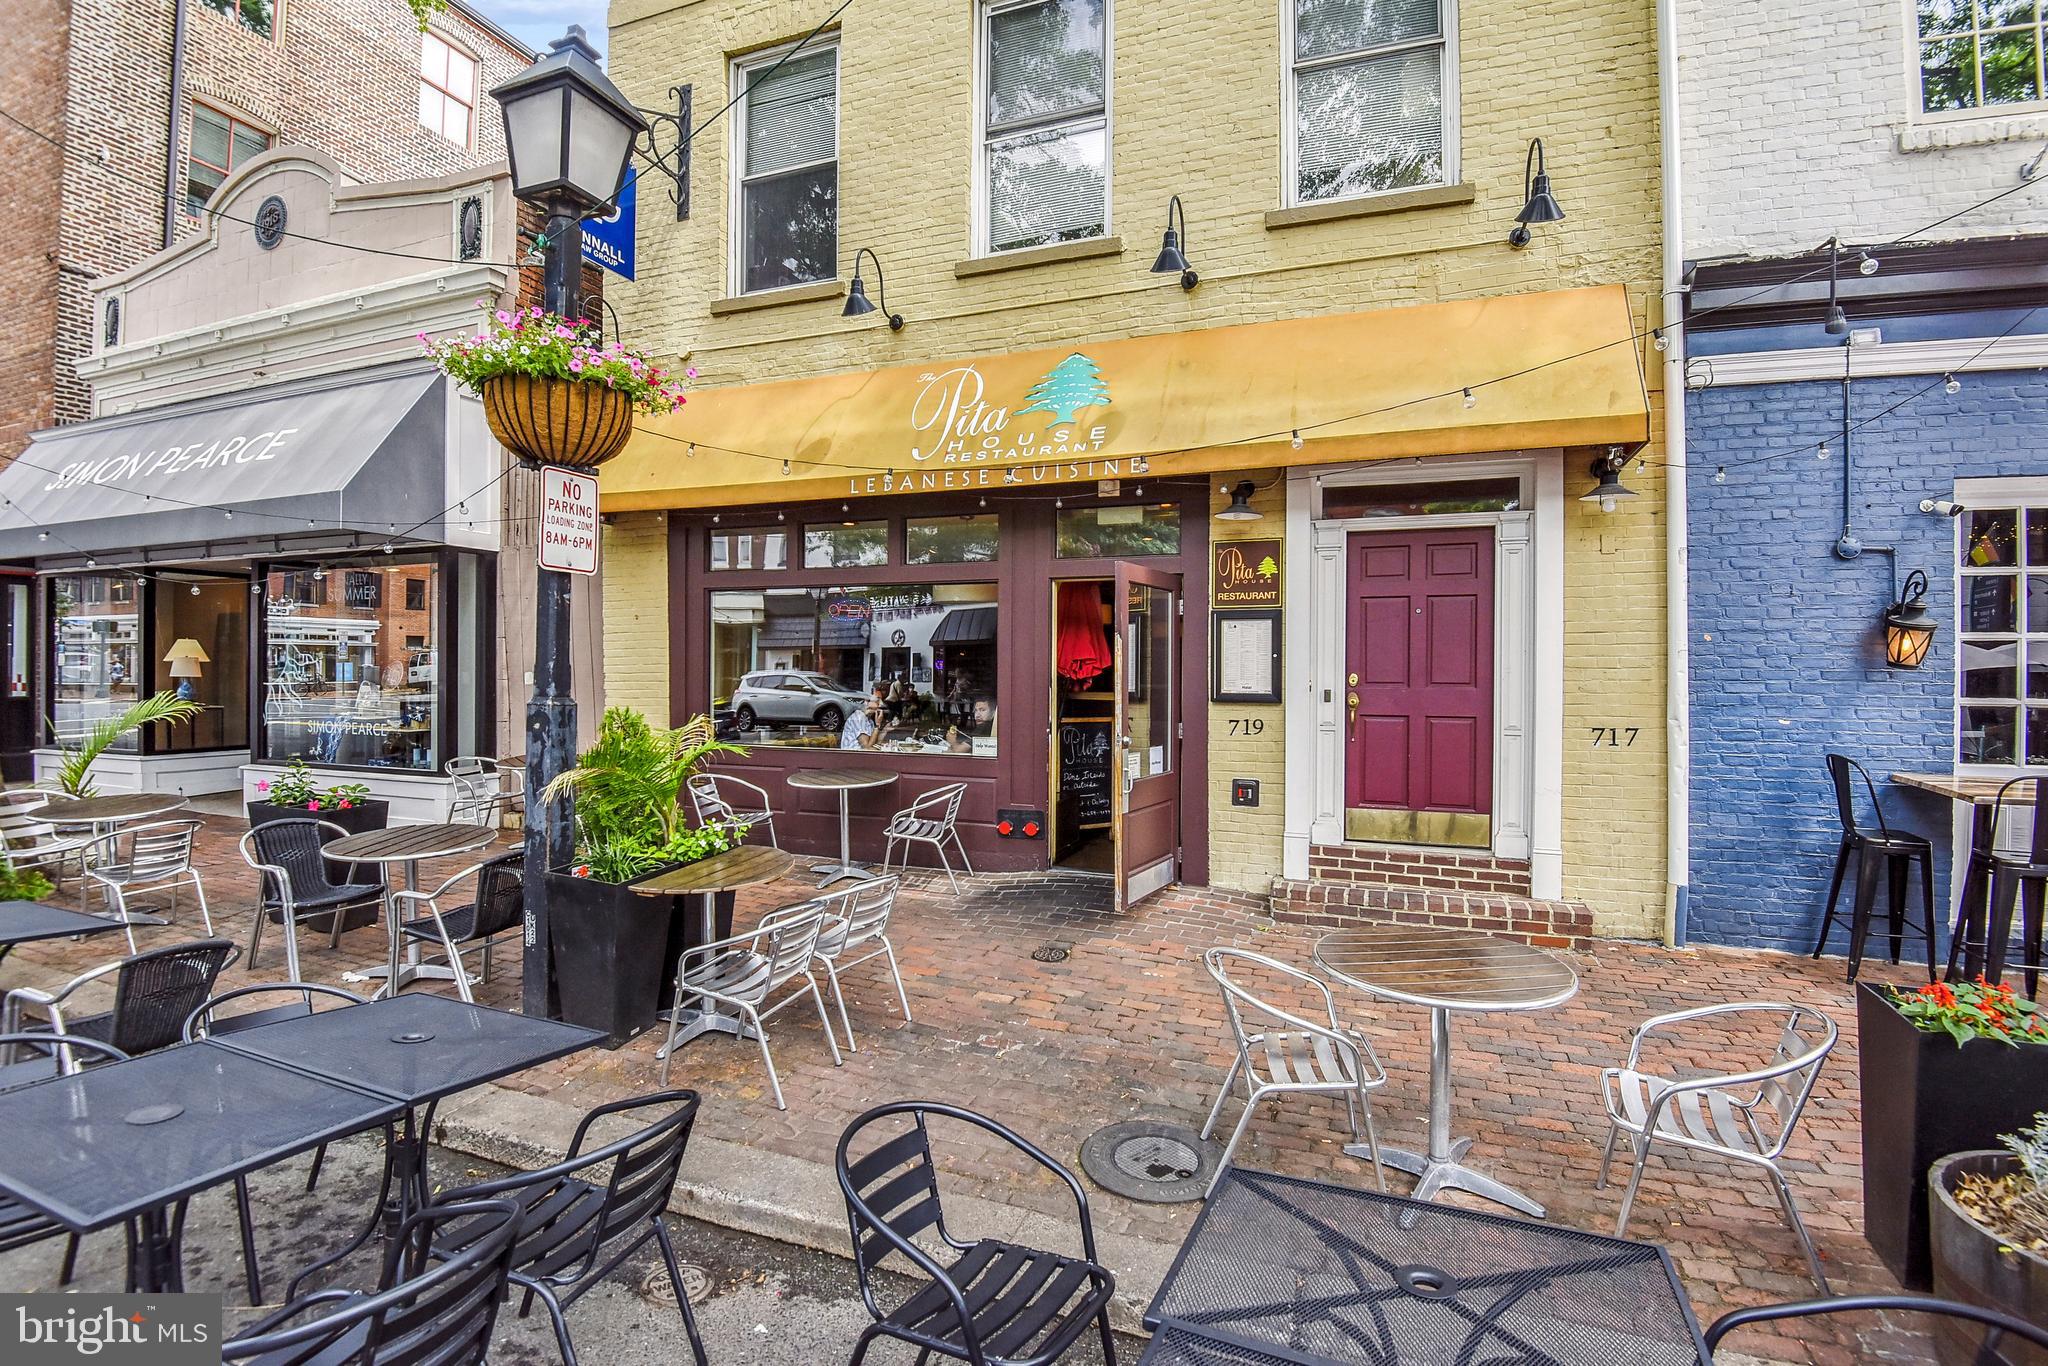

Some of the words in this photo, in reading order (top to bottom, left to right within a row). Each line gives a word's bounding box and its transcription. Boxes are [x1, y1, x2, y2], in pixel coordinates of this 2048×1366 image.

[581, 229, 625, 264] NNALL
[581, 242, 592, 254] AW
[593, 249, 619, 266] GROUP
[917, 373, 937, 383] The
[911, 360, 1010, 461] Pita
[949, 426, 1107, 452] HOUSE
[44, 450, 156, 491] SIMON
[145, 428, 299, 477] PEARCE
[944, 441, 1104, 463] RESTAURANT
[1010, 457, 1142, 482] CUISINE
[562, 480, 581, 501] NO
[548, 498, 593, 519] PARKING
[546, 514, 575, 529] LOADING
[577, 521, 593, 533] ZONE
[545, 531, 593, 551] 8AM-6PM
[1218, 546, 1255, 589] Pita
[327, 585, 377, 602] SUMMER
[1217, 591, 1278, 601] RESTAURANT
[828, 603, 871, 618] OPEN
[307, 719, 342, 735] SIMON
[346, 721, 388, 737] PEARCE
[1228, 718, 1264, 736] 719
[1591, 727, 1639, 747] 717
[653, 1274, 703, 1292] WAER
